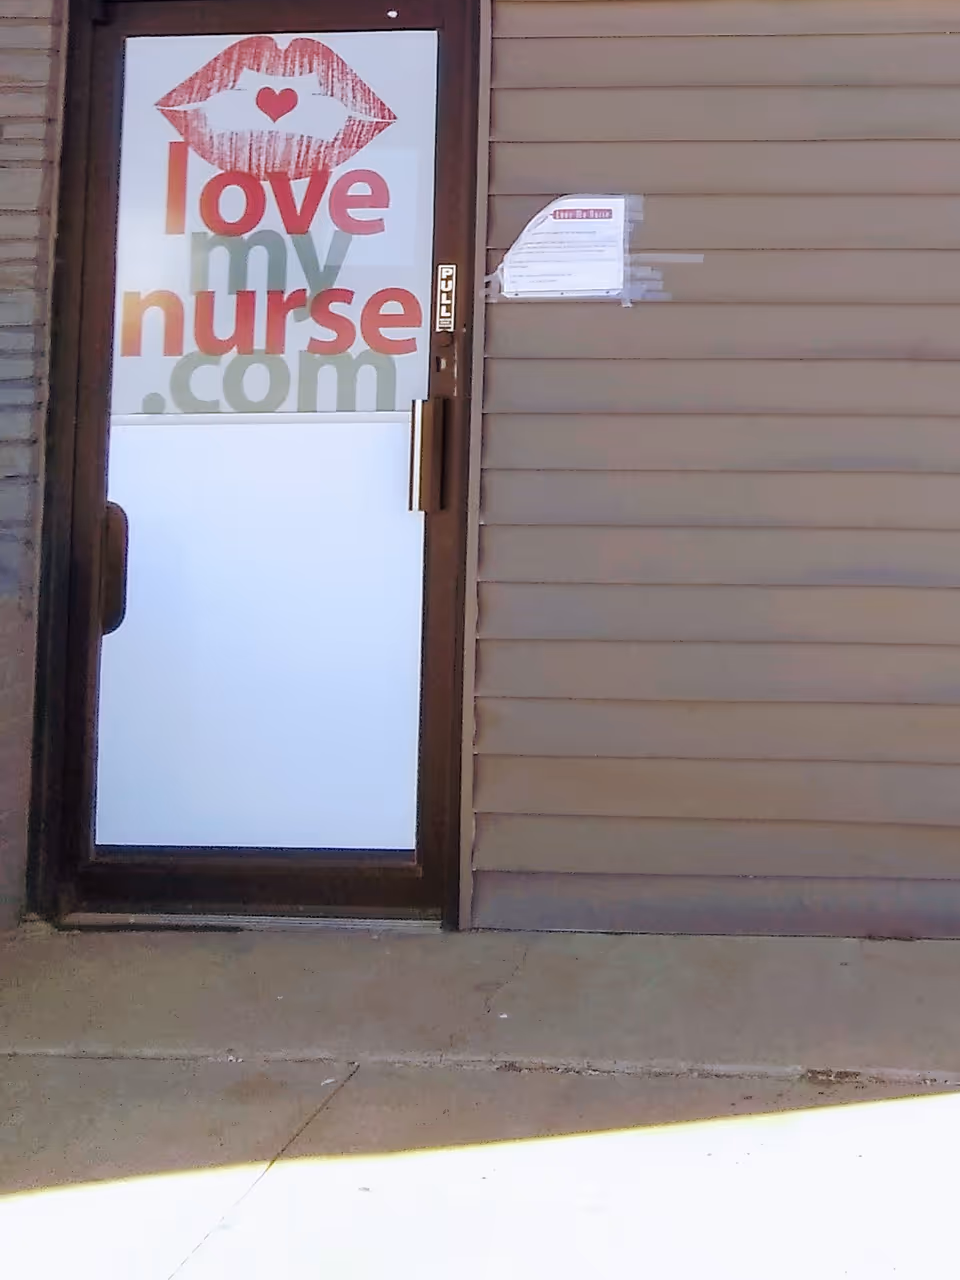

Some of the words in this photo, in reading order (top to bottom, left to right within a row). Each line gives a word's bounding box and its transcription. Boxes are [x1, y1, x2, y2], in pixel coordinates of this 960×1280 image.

[163, 140, 390, 236] love
[191, 228, 353, 322] my
[439, 267, 454, 318] PULL
[120, 287, 423, 356] nurse
[142, 349, 398, 413] .com
